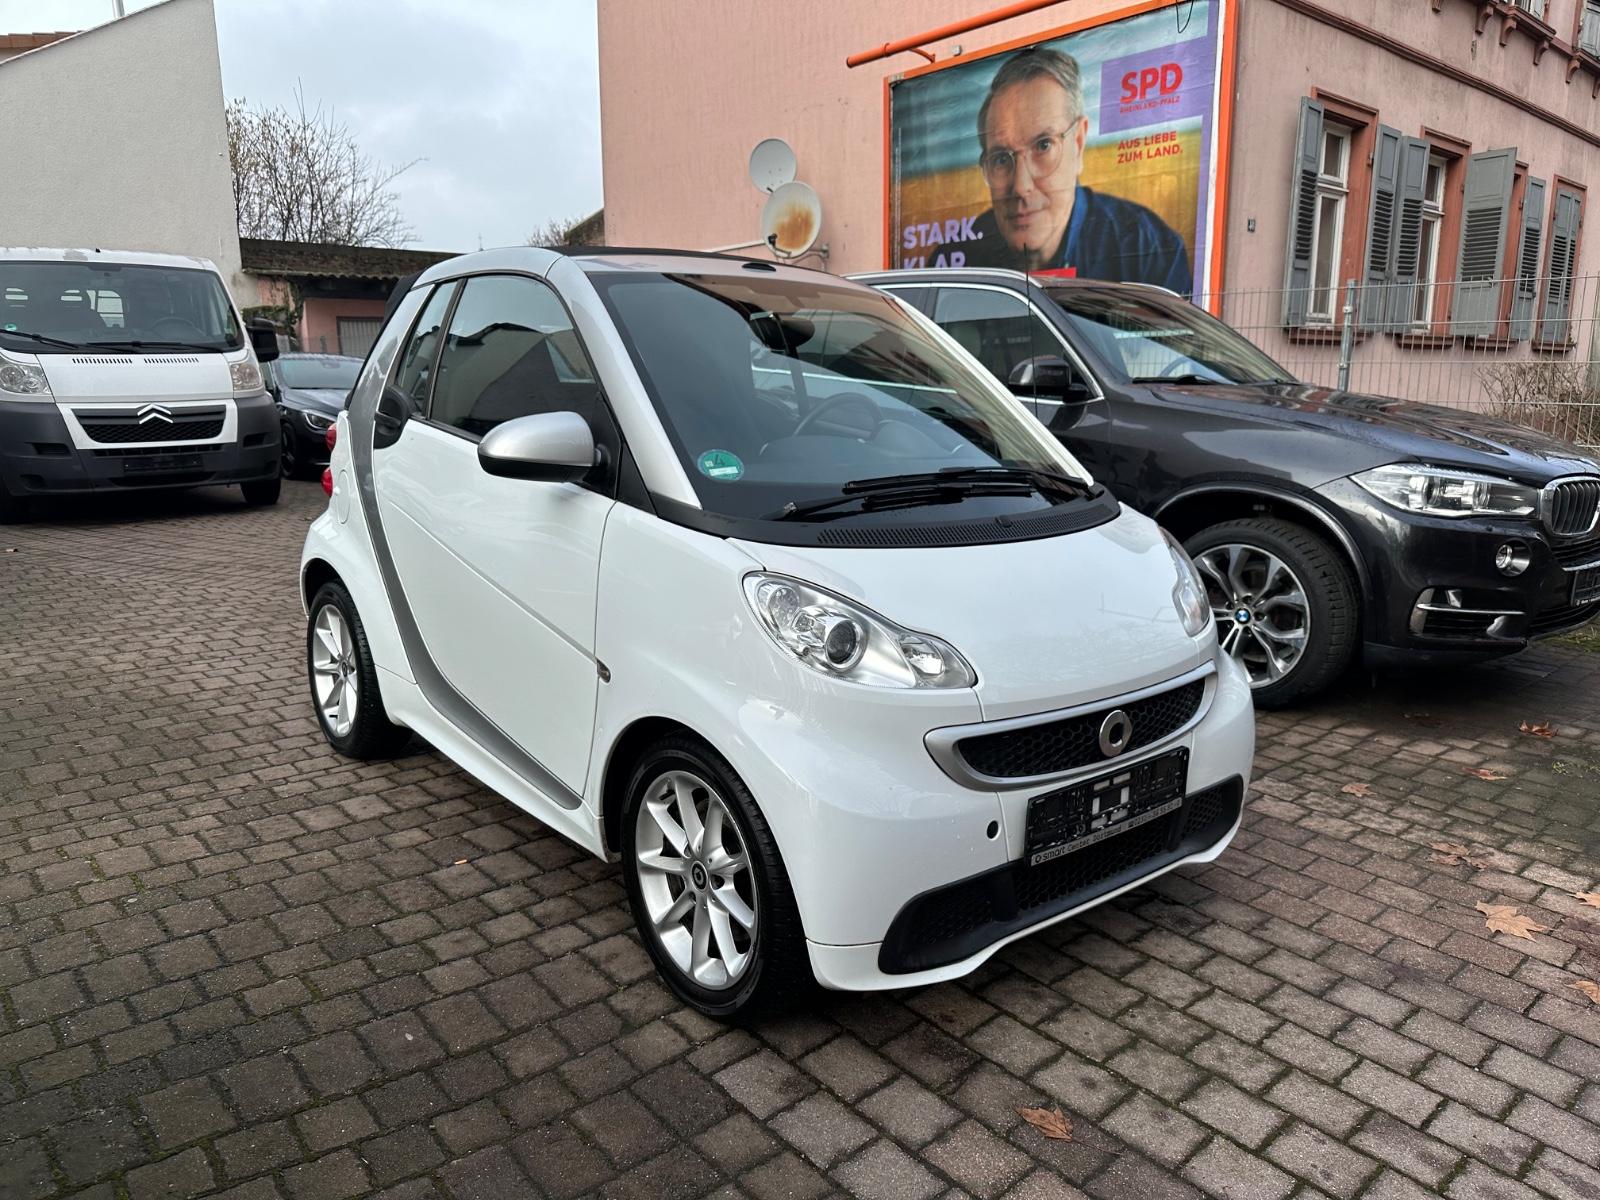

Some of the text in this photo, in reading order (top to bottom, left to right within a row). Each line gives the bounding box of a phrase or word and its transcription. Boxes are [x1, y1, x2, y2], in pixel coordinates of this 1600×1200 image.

[1120, 62, 1183, 104] SPD
[1120, 95, 1180, 114] RHEINLAND-PFALZ
[1117, 131, 1177, 151] AUS LIEBE
[1117, 144, 1183, 164] ZUM LAND.
[903, 215, 984, 250] STARK.
[1042, 845, 1066, 861] smart
